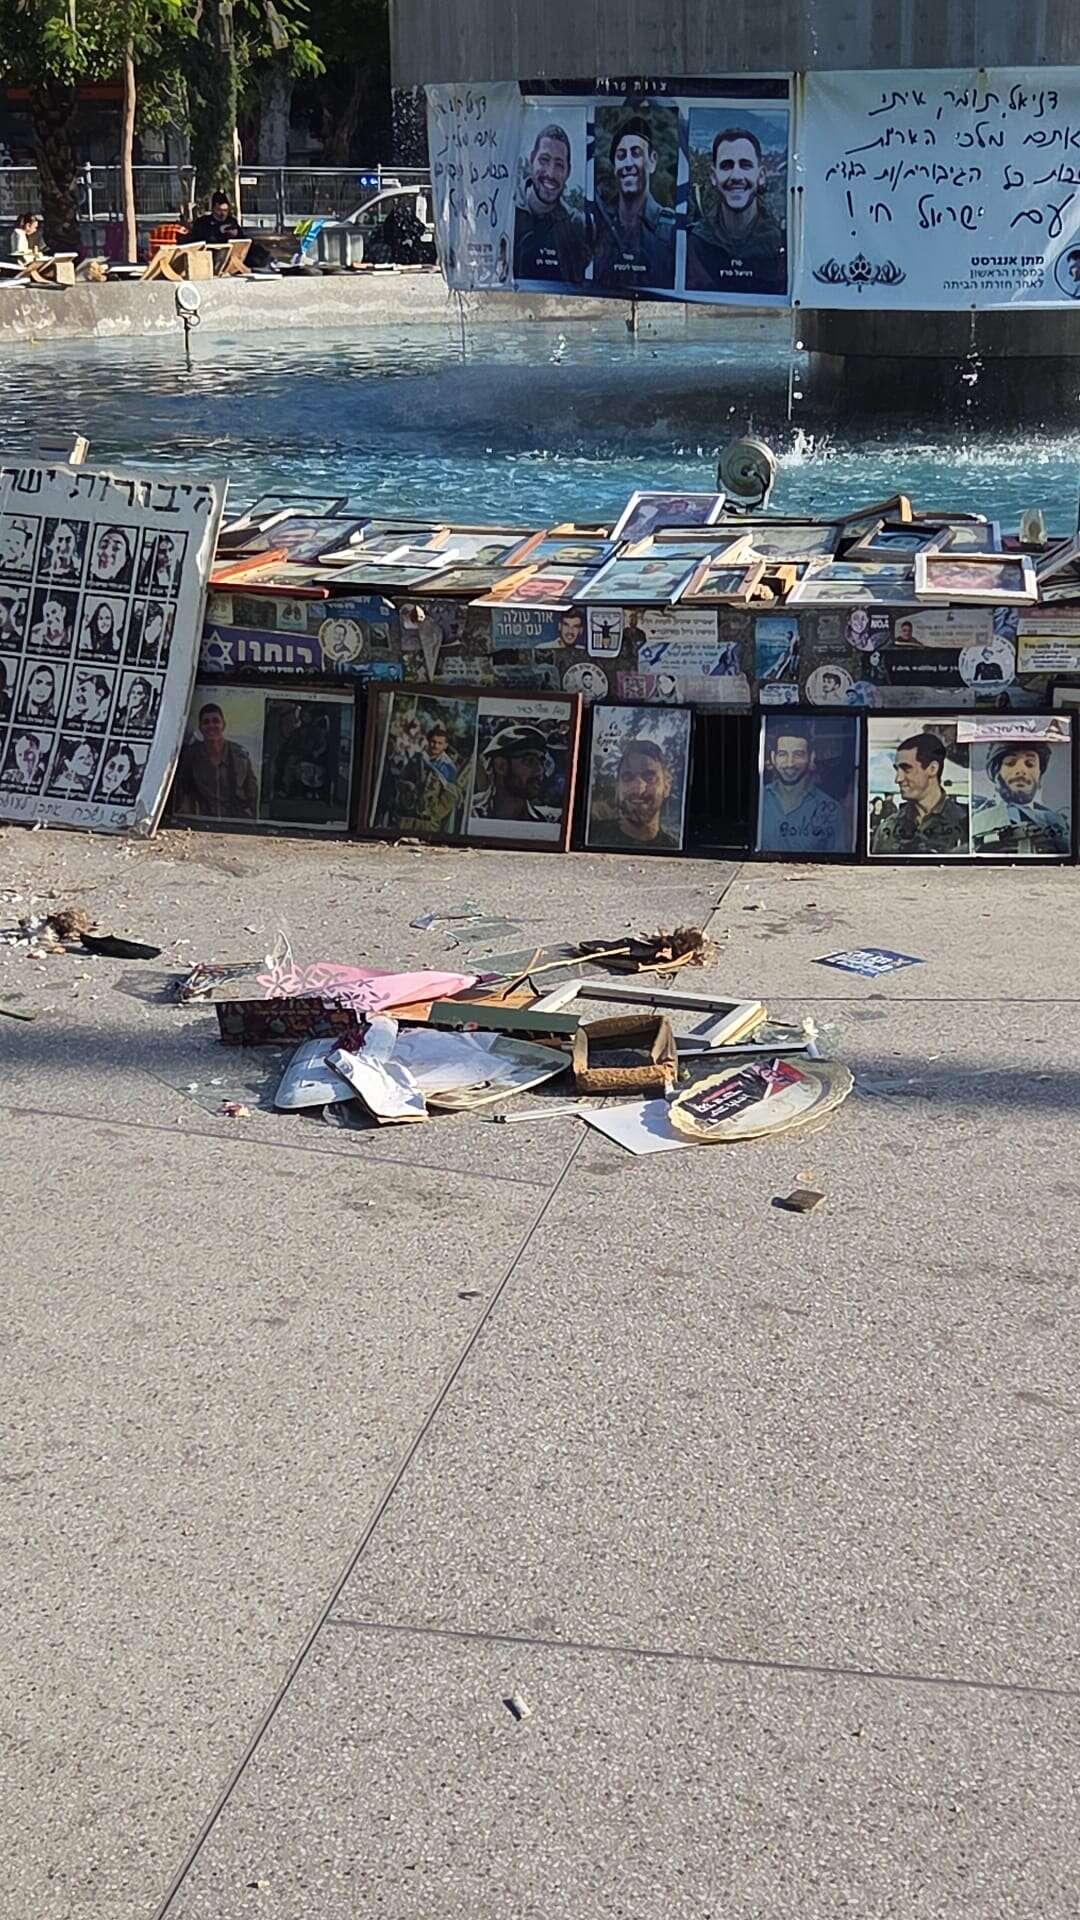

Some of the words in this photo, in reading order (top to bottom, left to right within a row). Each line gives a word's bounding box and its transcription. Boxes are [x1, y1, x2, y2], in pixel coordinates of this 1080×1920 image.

[869, 90, 927, 116] איתי
[955, 121, 1004, 148] מלכי
[919, 194, 984, 230] ישראל
[1010, 194, 1075, 237] עם
[971, 256, 1018, 266] אנגרסט
[1021, 256, 1044, 267] מתן
[970, 269, 1009, 279] הראשון
[943, 280, 978, 289] הביתה
